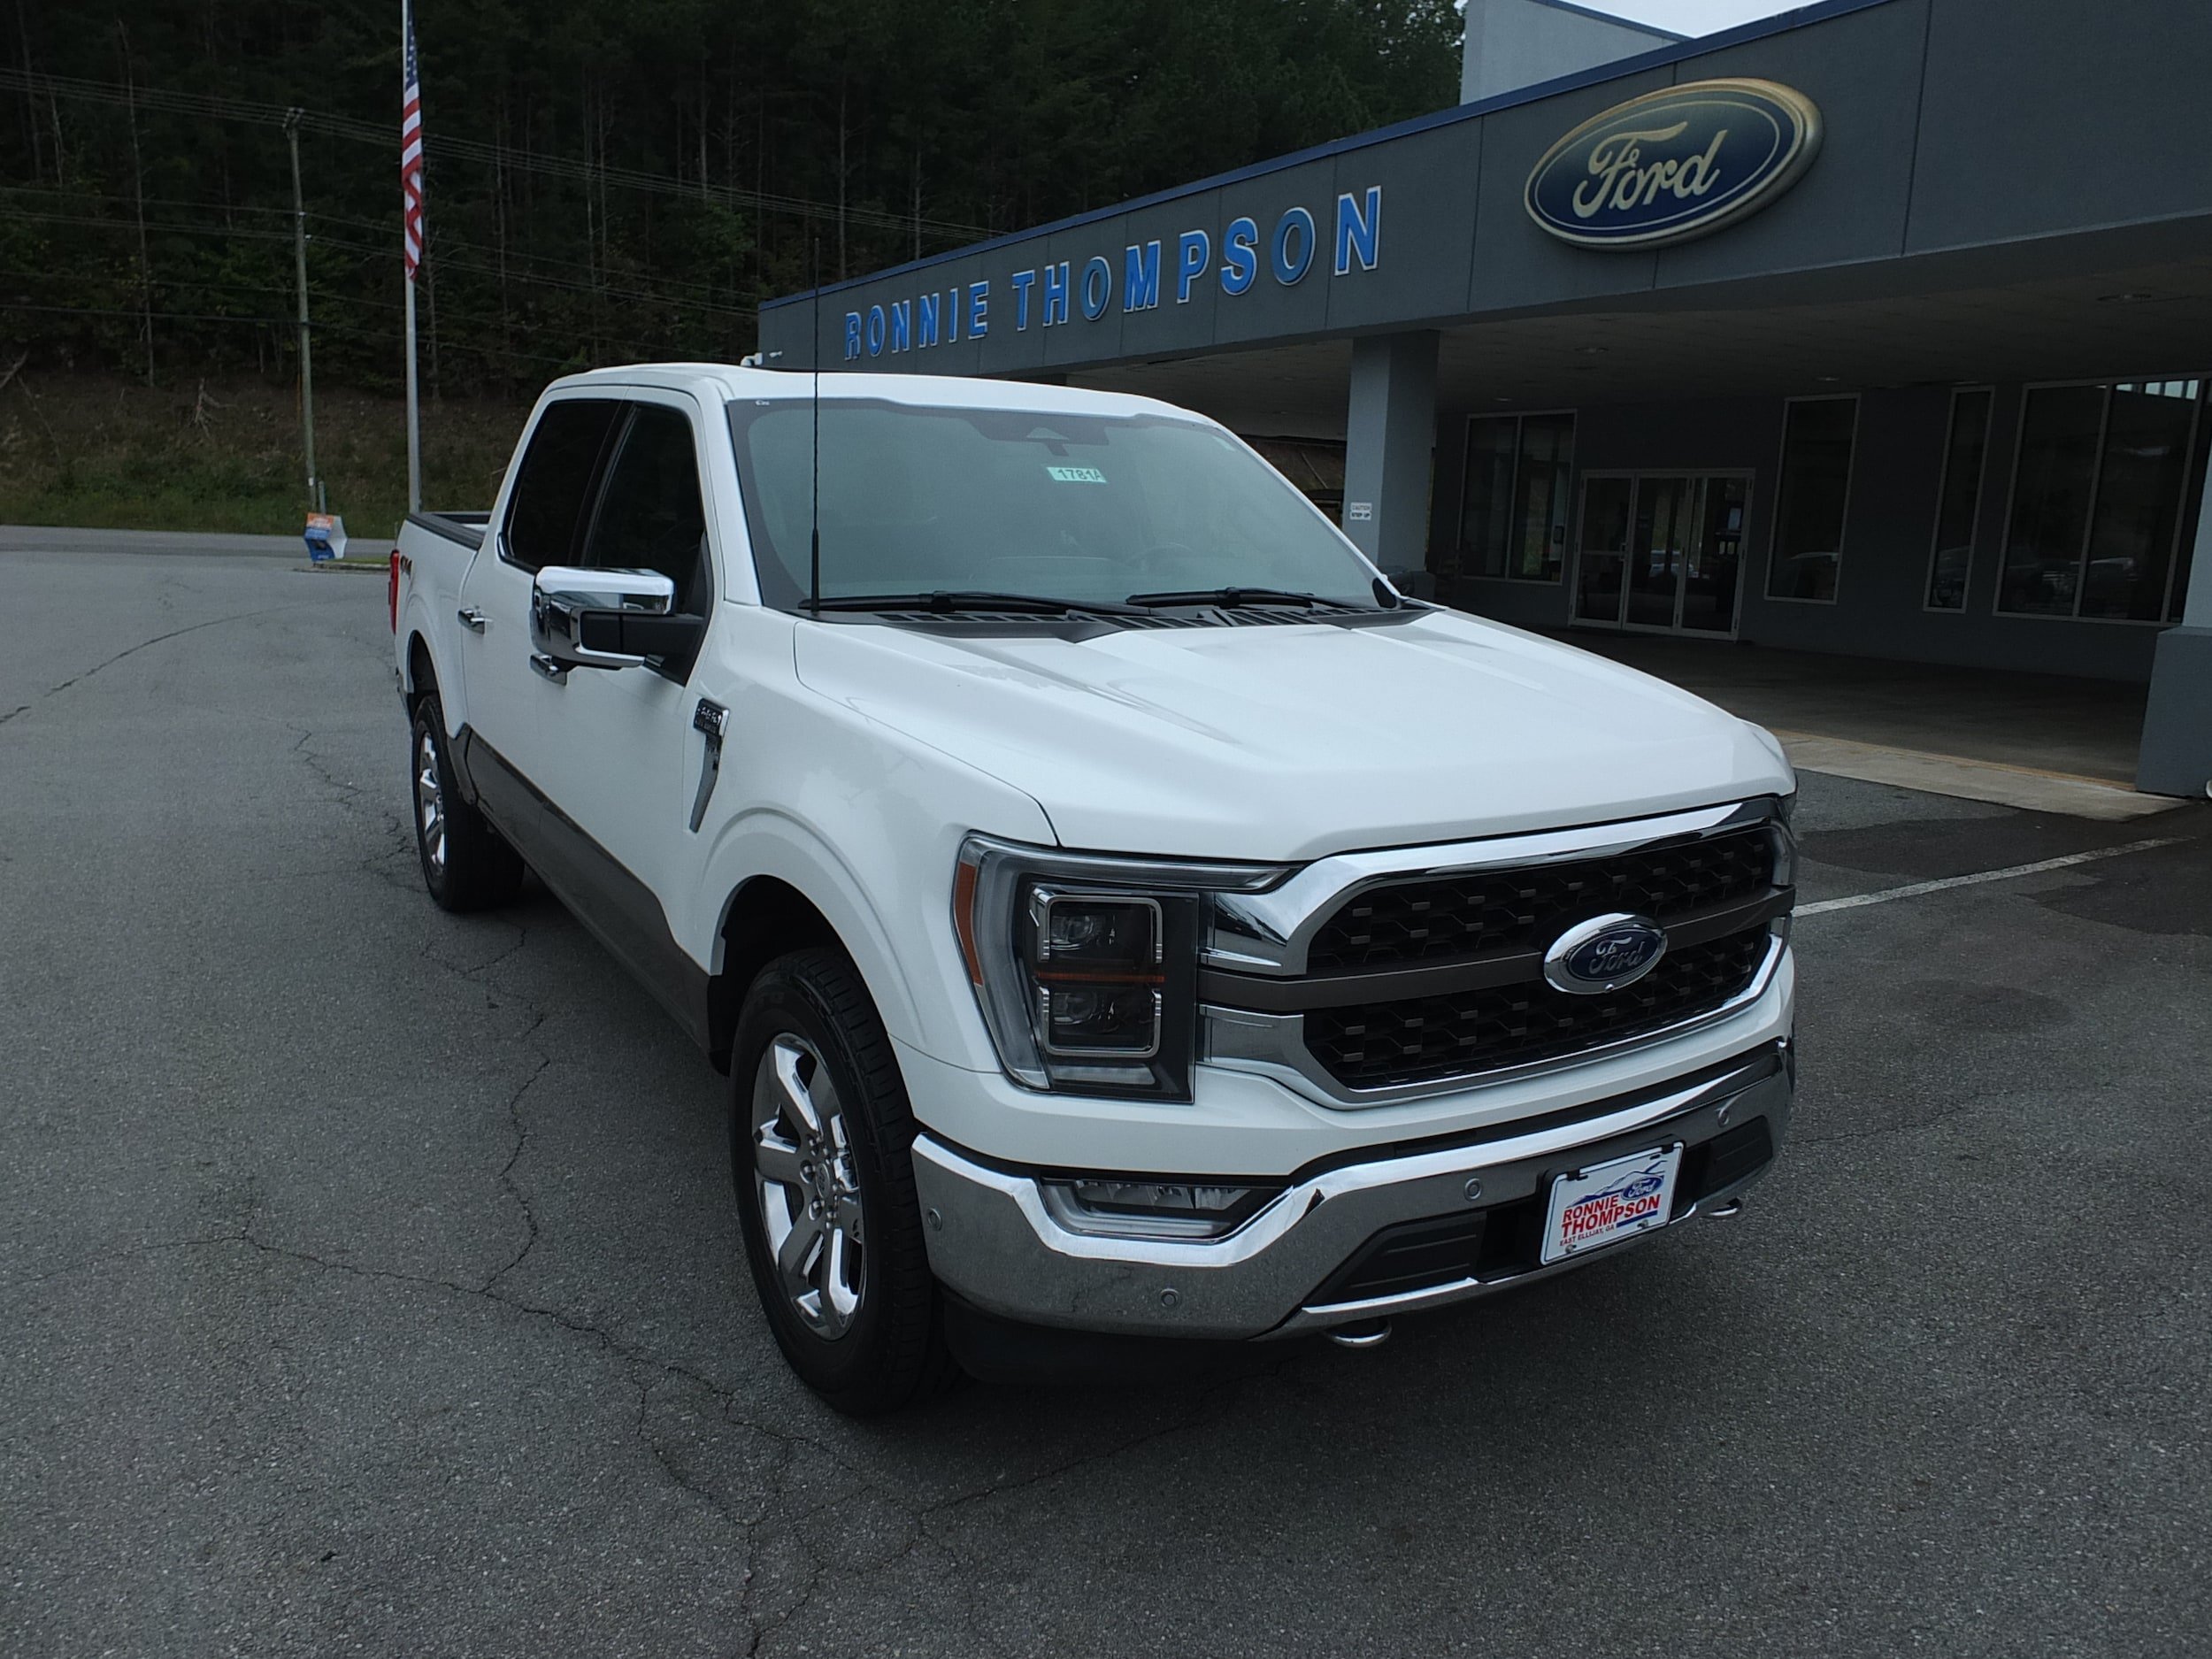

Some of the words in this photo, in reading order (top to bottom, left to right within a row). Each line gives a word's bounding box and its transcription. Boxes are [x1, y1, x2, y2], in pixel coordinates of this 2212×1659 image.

[1572, 120, 1729, 219] Ford
[844, 280, 990, 361] RONNIE
[1011, 185, 1382, 332] THOMPSON
[1589, 936, 1646, 974] Ford
[1628, 1179, 1656, 1197] Ford
[1560, 1194, 1662, 1239] THOMPSON
[1563, 1194, 1619, 1223] RONNIE
[1559, 1235, 1576, 1246] EAST
